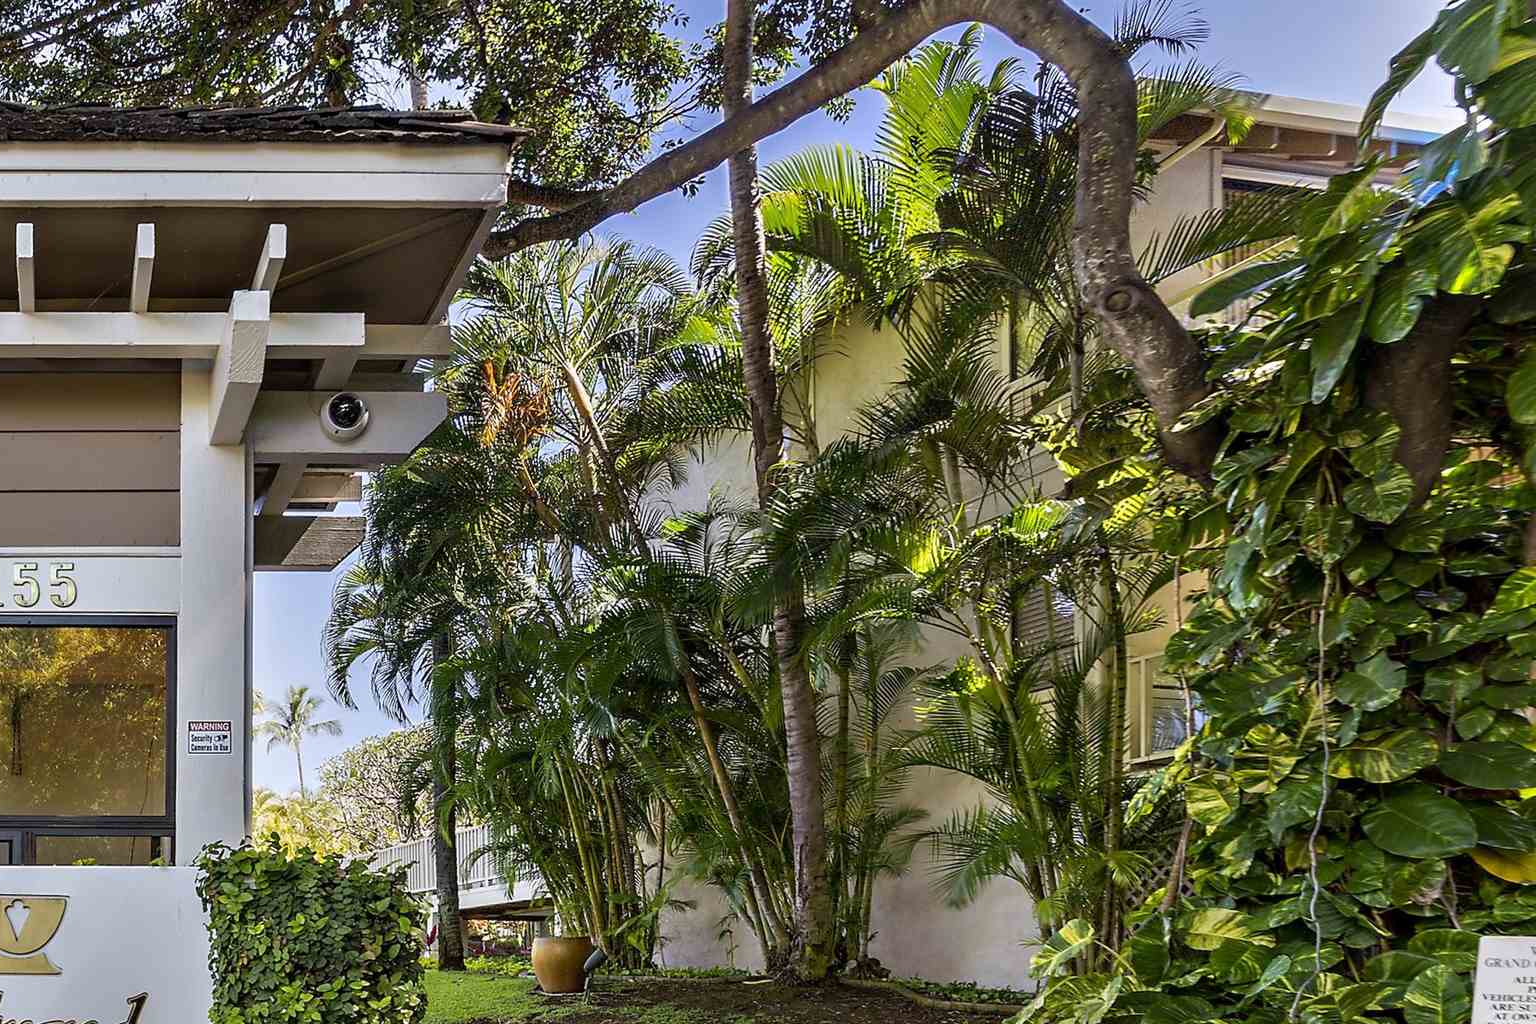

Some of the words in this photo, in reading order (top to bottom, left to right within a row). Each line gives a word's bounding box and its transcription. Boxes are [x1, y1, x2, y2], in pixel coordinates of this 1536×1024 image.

[190, 722, 230, 731] WARNING
[191, 734, 213, 744] Security
[1484, 957, 1530, 969] GRAND
[1490, 1003, 1514, 1011] ARE
